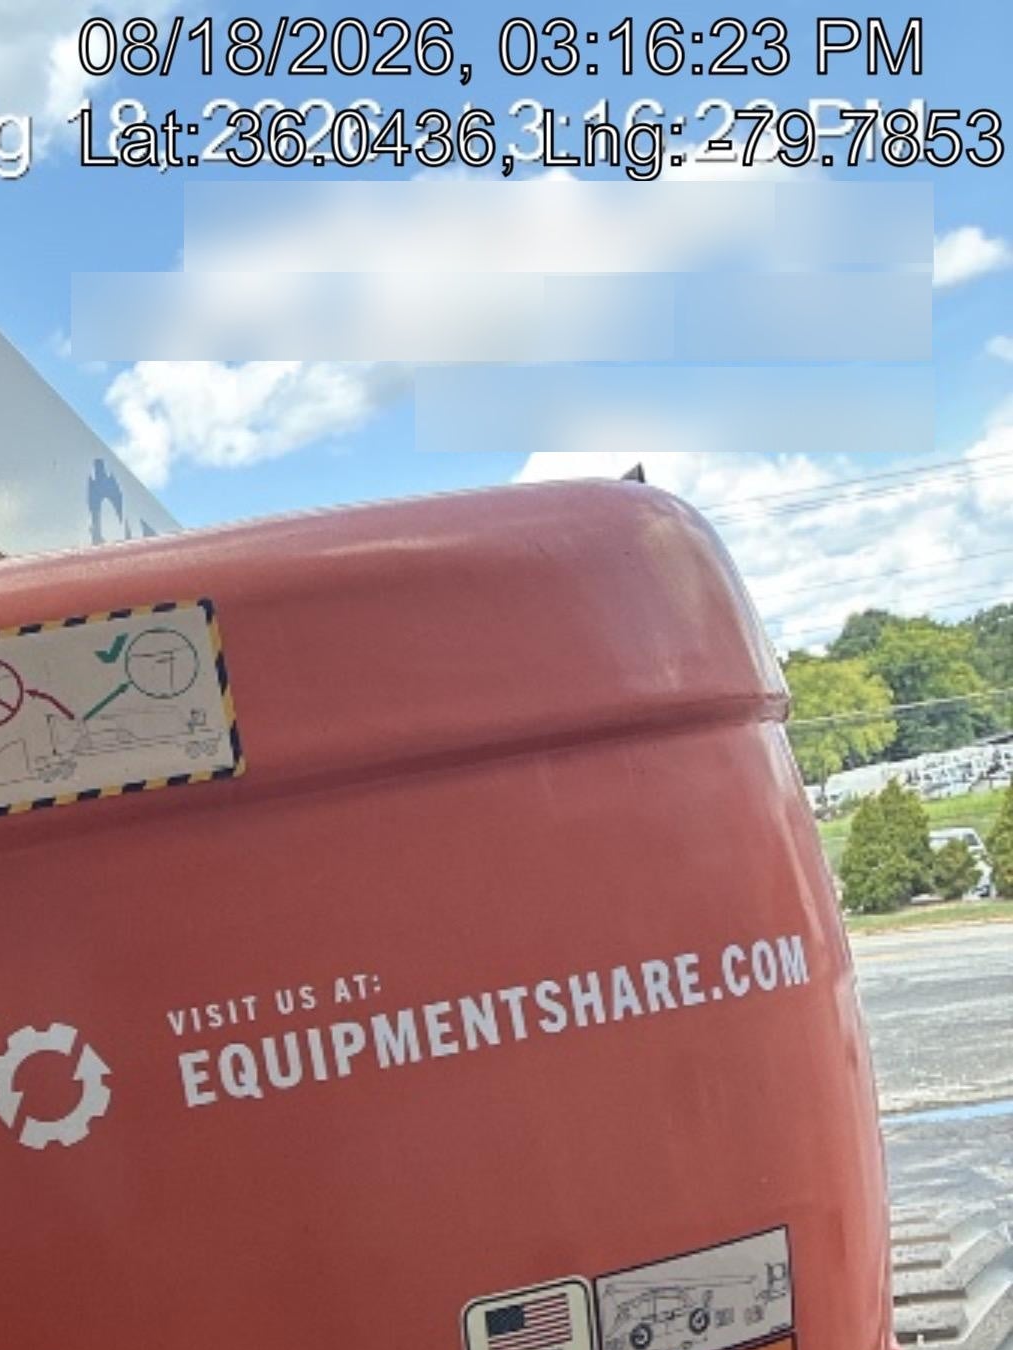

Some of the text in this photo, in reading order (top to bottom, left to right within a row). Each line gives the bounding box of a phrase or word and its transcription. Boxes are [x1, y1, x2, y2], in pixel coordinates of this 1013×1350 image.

[167, 974, 382, 1036] VISIT US AT:
[178, 934, 812, 1107] EQUIPMENTSHARE.COM
